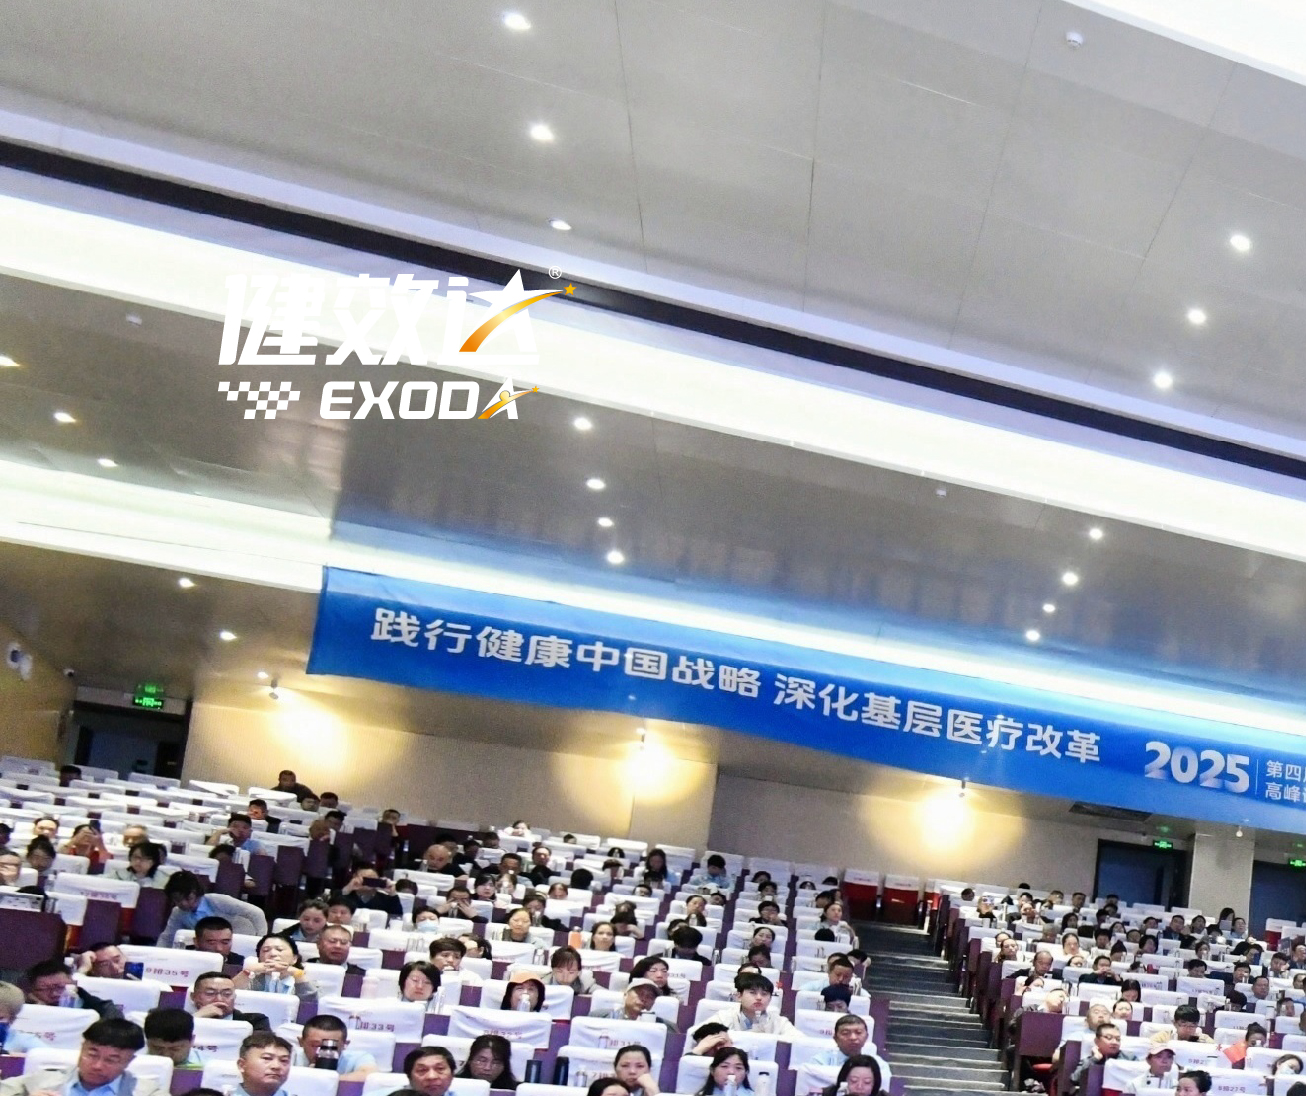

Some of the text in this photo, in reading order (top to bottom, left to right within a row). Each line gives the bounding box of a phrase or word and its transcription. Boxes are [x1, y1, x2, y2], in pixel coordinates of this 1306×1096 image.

[370, 607, 1101, 763] 践行健康中国战略 深化基层医疗改革
[1145, 741, 1250, 793] 2025
